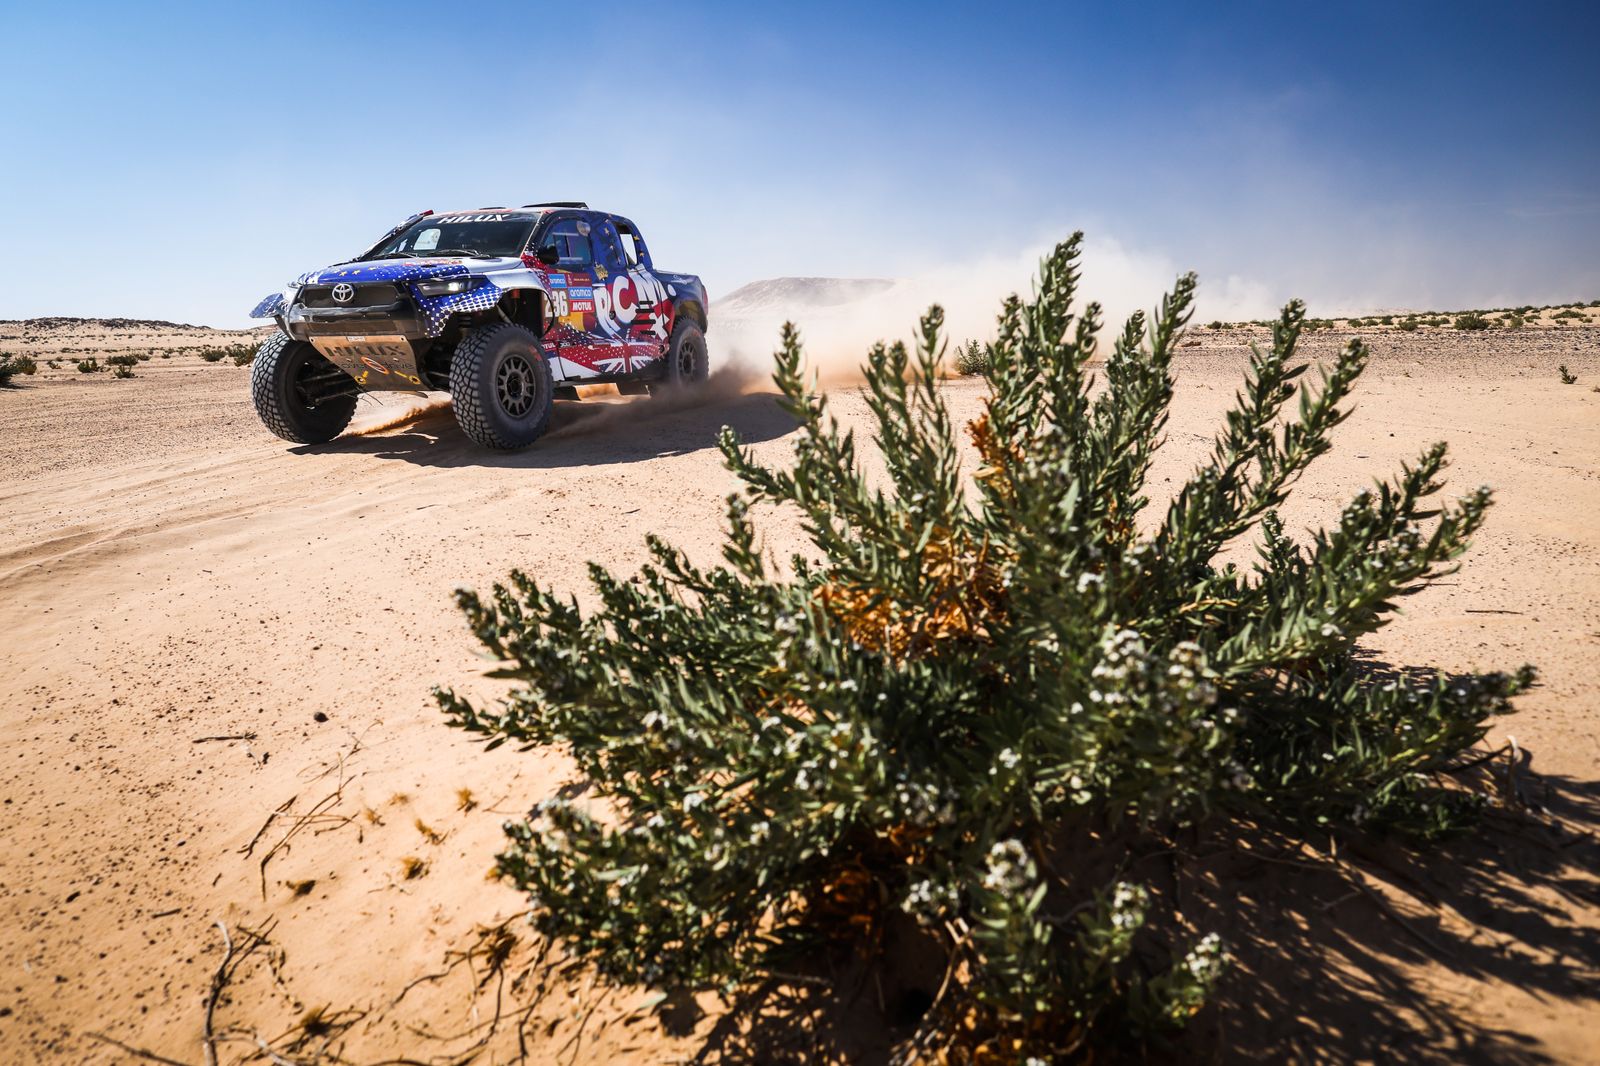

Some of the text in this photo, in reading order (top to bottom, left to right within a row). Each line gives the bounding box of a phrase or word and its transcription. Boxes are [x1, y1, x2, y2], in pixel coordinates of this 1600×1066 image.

[437, 213, 511, 224] HILUX
[570, 288, 592, 297] aramco
[544, 290, 568, 318] 236
[572, 301, 592, 311] MOTUL
[324, 346, 407, 357] HILUX
